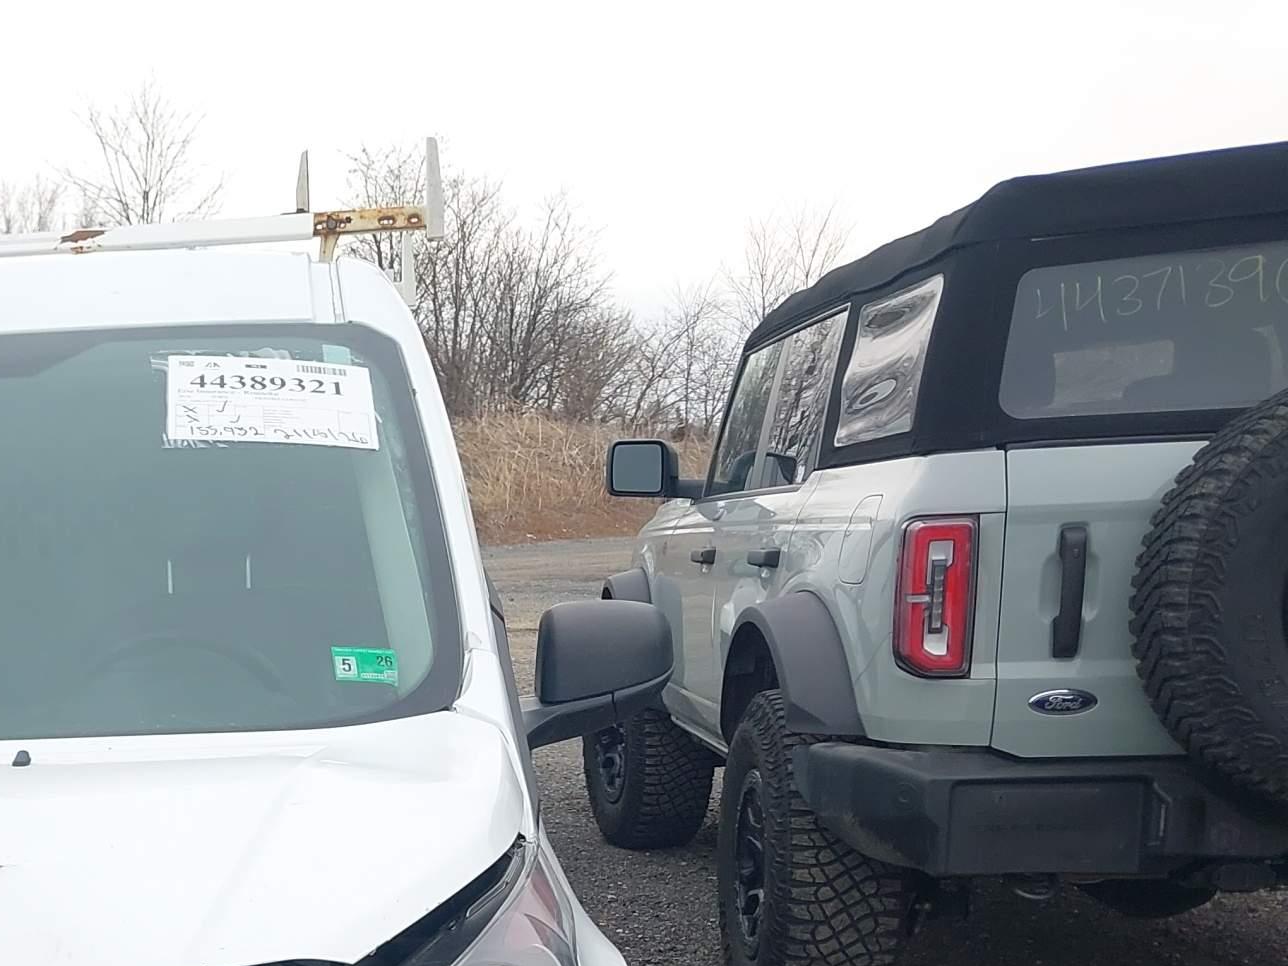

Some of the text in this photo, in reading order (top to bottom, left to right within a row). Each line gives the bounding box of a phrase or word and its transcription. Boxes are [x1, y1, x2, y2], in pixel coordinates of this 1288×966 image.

[189, 373, 345, 397] 44389321
[341, 655, 393, 673] 5 26
[1044, 695, 1083, 710] Ford
